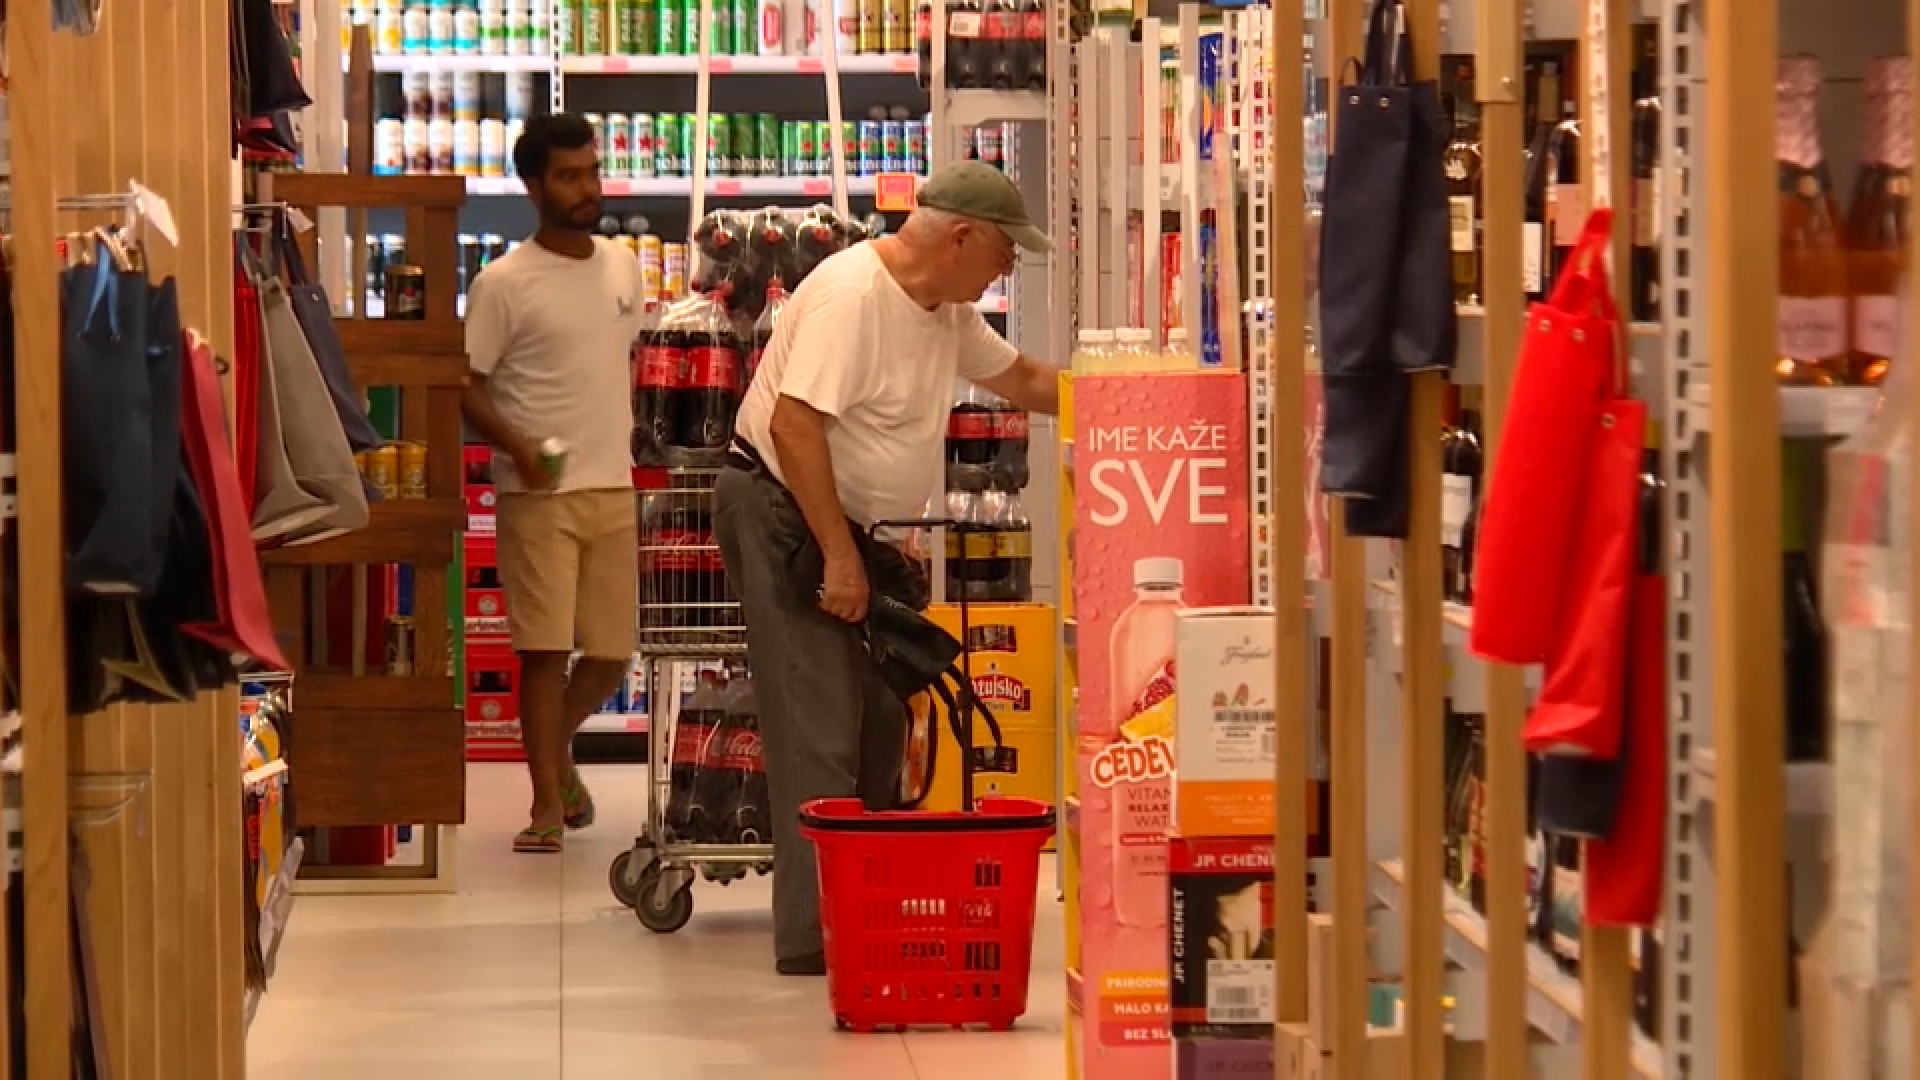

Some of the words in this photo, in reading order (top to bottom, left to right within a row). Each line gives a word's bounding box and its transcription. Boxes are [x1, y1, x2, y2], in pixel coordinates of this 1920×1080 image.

[1088, 426, 1139, 452] IME
[1147, 418, 1227, 452] KAŽE
[1088, 457, 1229, 527] SVE
[1172, 886, 1185, 958] CHENET
[1113, 1002, 1151, 1015] MALO
[1124, 1028, 1149, 1040] BEZ
